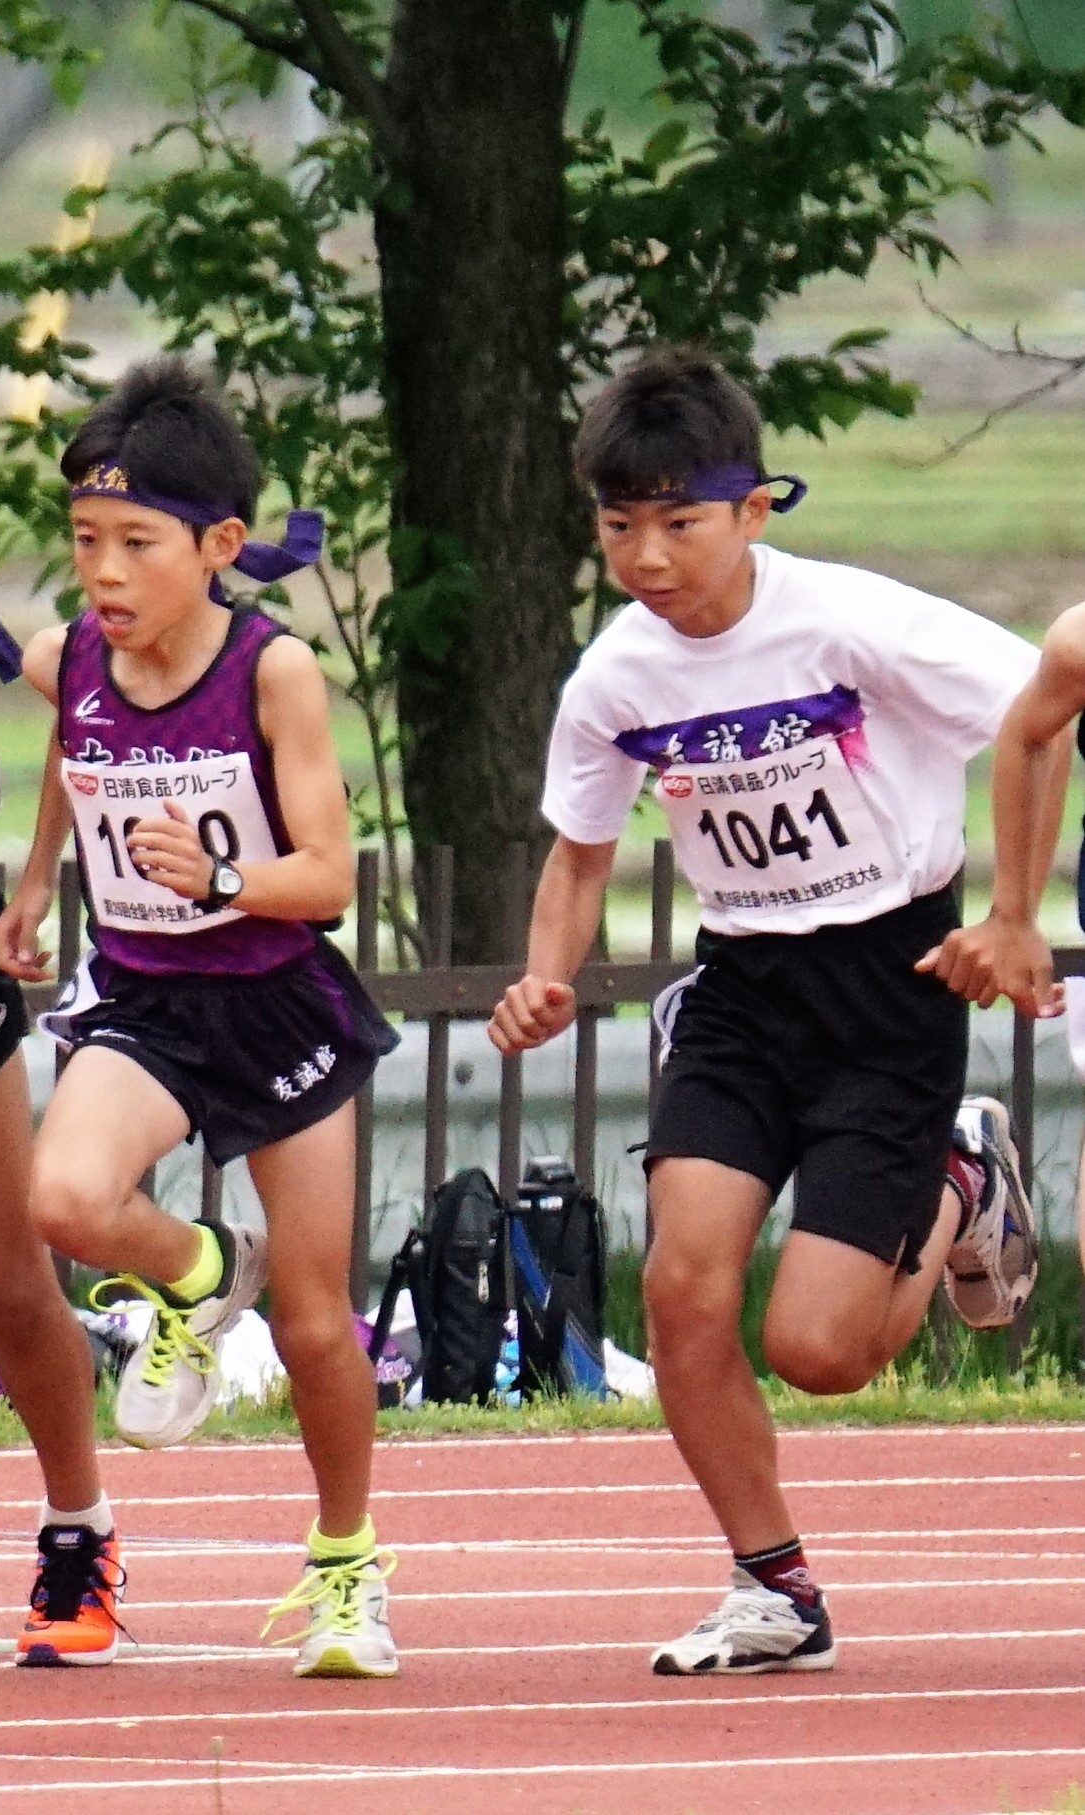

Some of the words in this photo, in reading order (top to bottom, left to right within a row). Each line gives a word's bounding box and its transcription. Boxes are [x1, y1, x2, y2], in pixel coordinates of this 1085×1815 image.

[103, 767, 239, 799] 日清食品グループ
[697, 748, 828, 795] 日清食品グループ
[97, 809, 241, 880] 10
[698, 787, 851, 869] 1041
